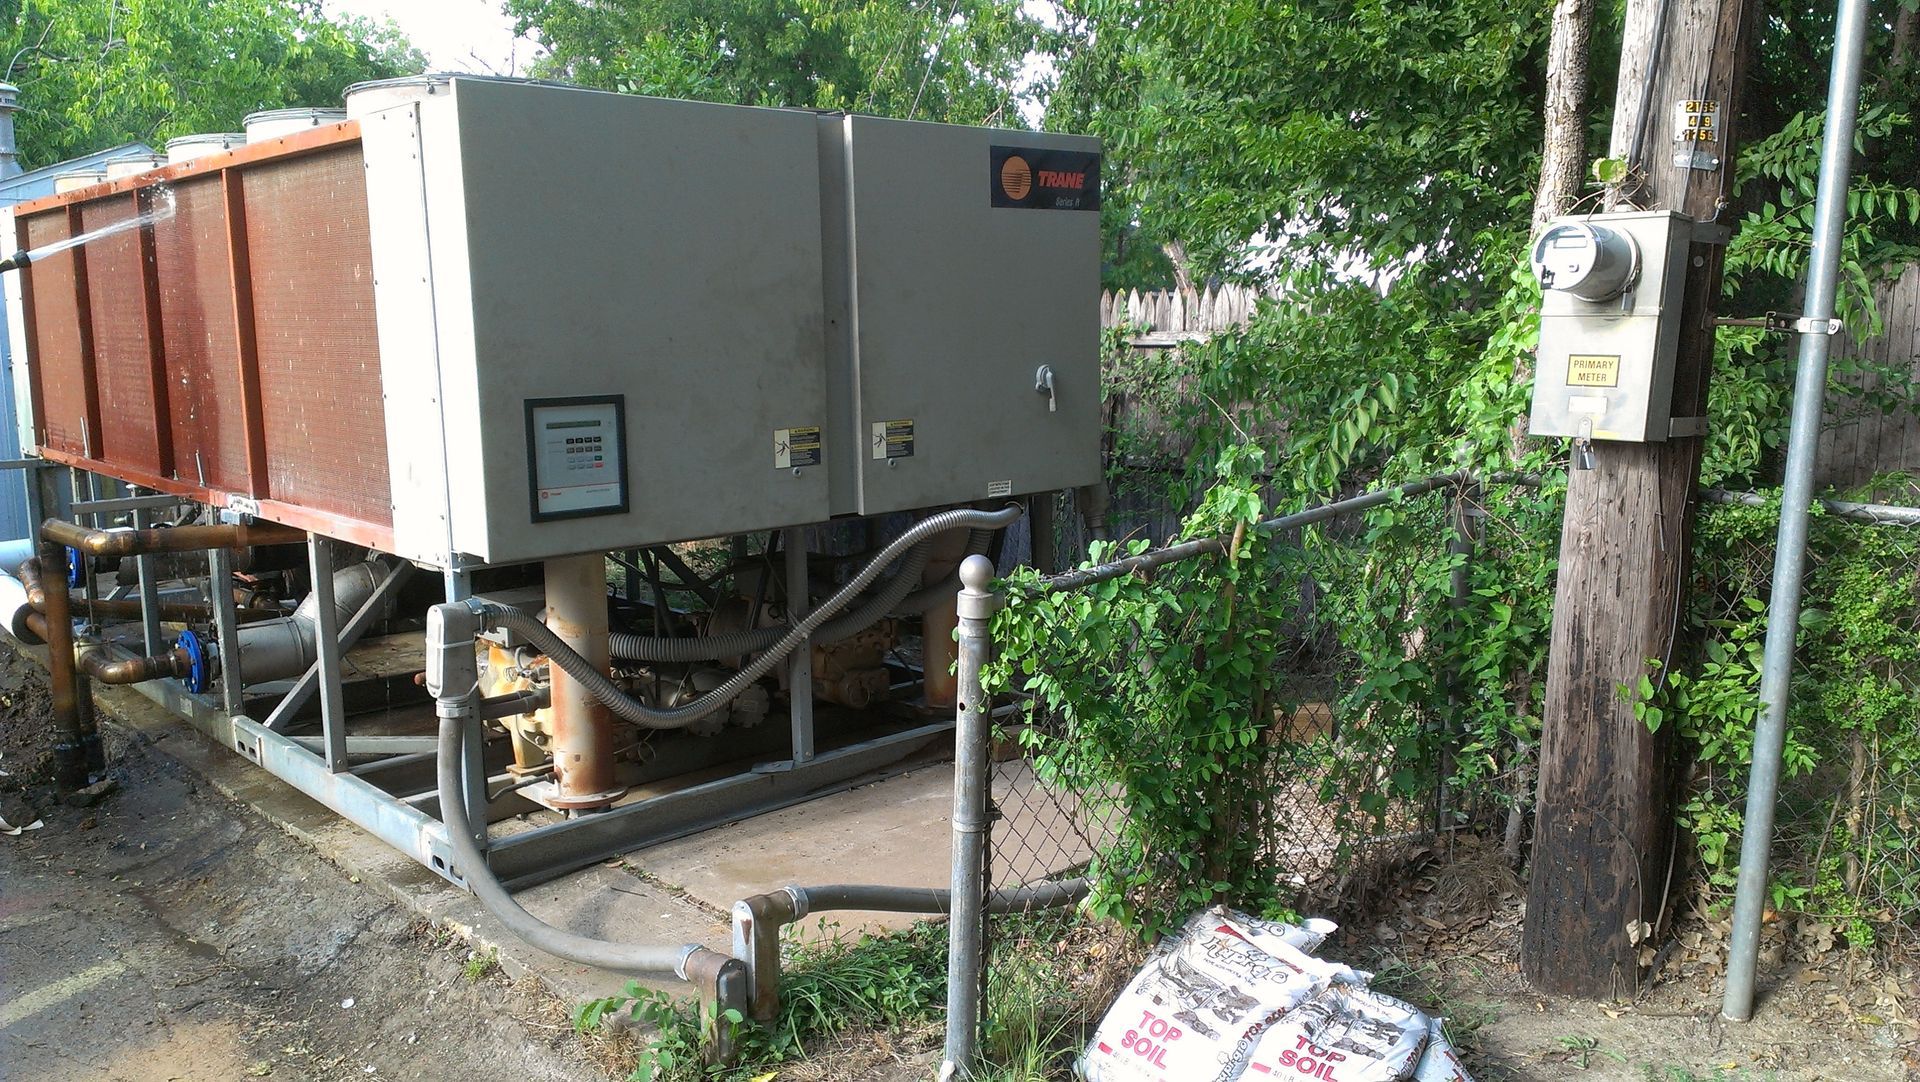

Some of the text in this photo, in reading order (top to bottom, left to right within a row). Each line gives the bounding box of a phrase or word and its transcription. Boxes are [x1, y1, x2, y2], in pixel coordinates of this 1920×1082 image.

[1038, 171, 1084, 188] TRANE
[1573, 359, 1614, 369] PRIMARY
[1577, 372, 1607, 382] METER
[1139, 1010, 1182, 1043] TOP
[1121, 1029, 1167, 1070] SOIL
[1296, 1034, 1346, 1062] TOP
[1279, 1049, 1338, 1082] SOIL
